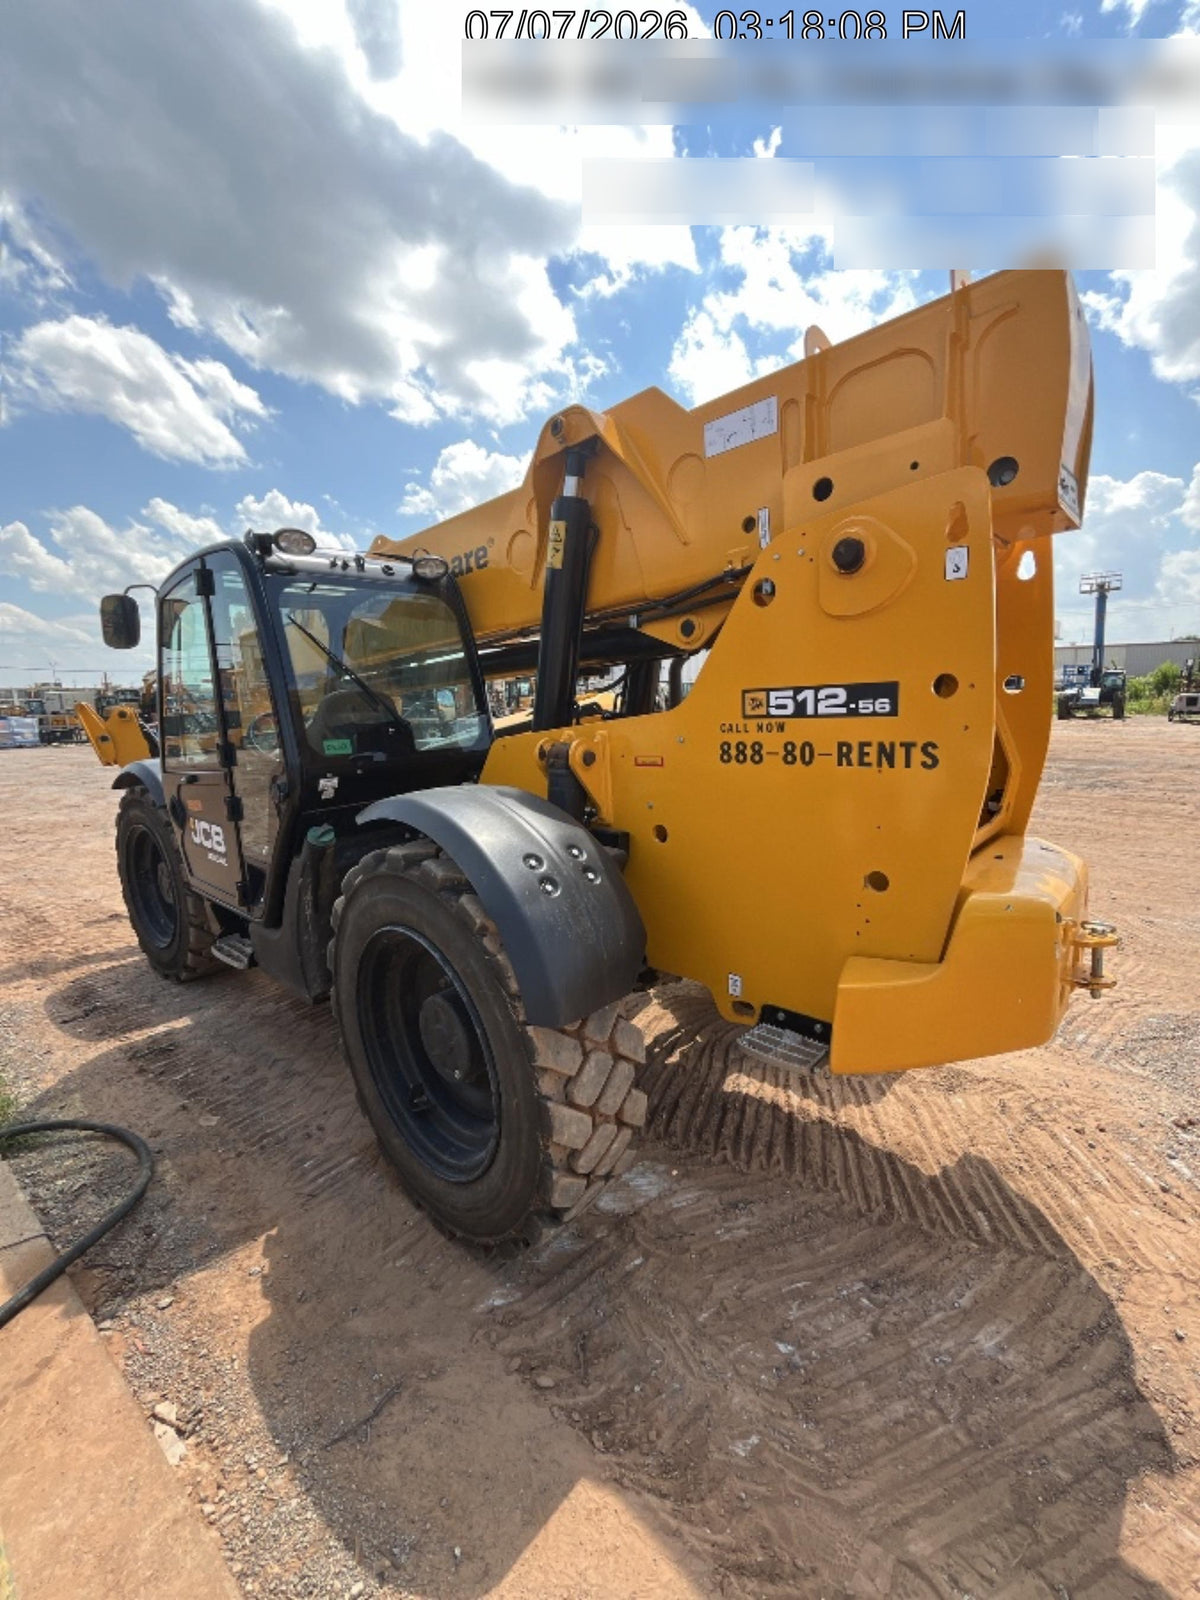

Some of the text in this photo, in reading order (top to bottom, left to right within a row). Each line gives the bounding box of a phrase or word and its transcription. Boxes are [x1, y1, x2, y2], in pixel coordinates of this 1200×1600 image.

[768, 687, 891, 716] 512-56
[719, 722, 785, 733] CALL NOW
[719, 741, 940, 770] 888-80-RENTS
[191, 818, 226, 853] JCB
